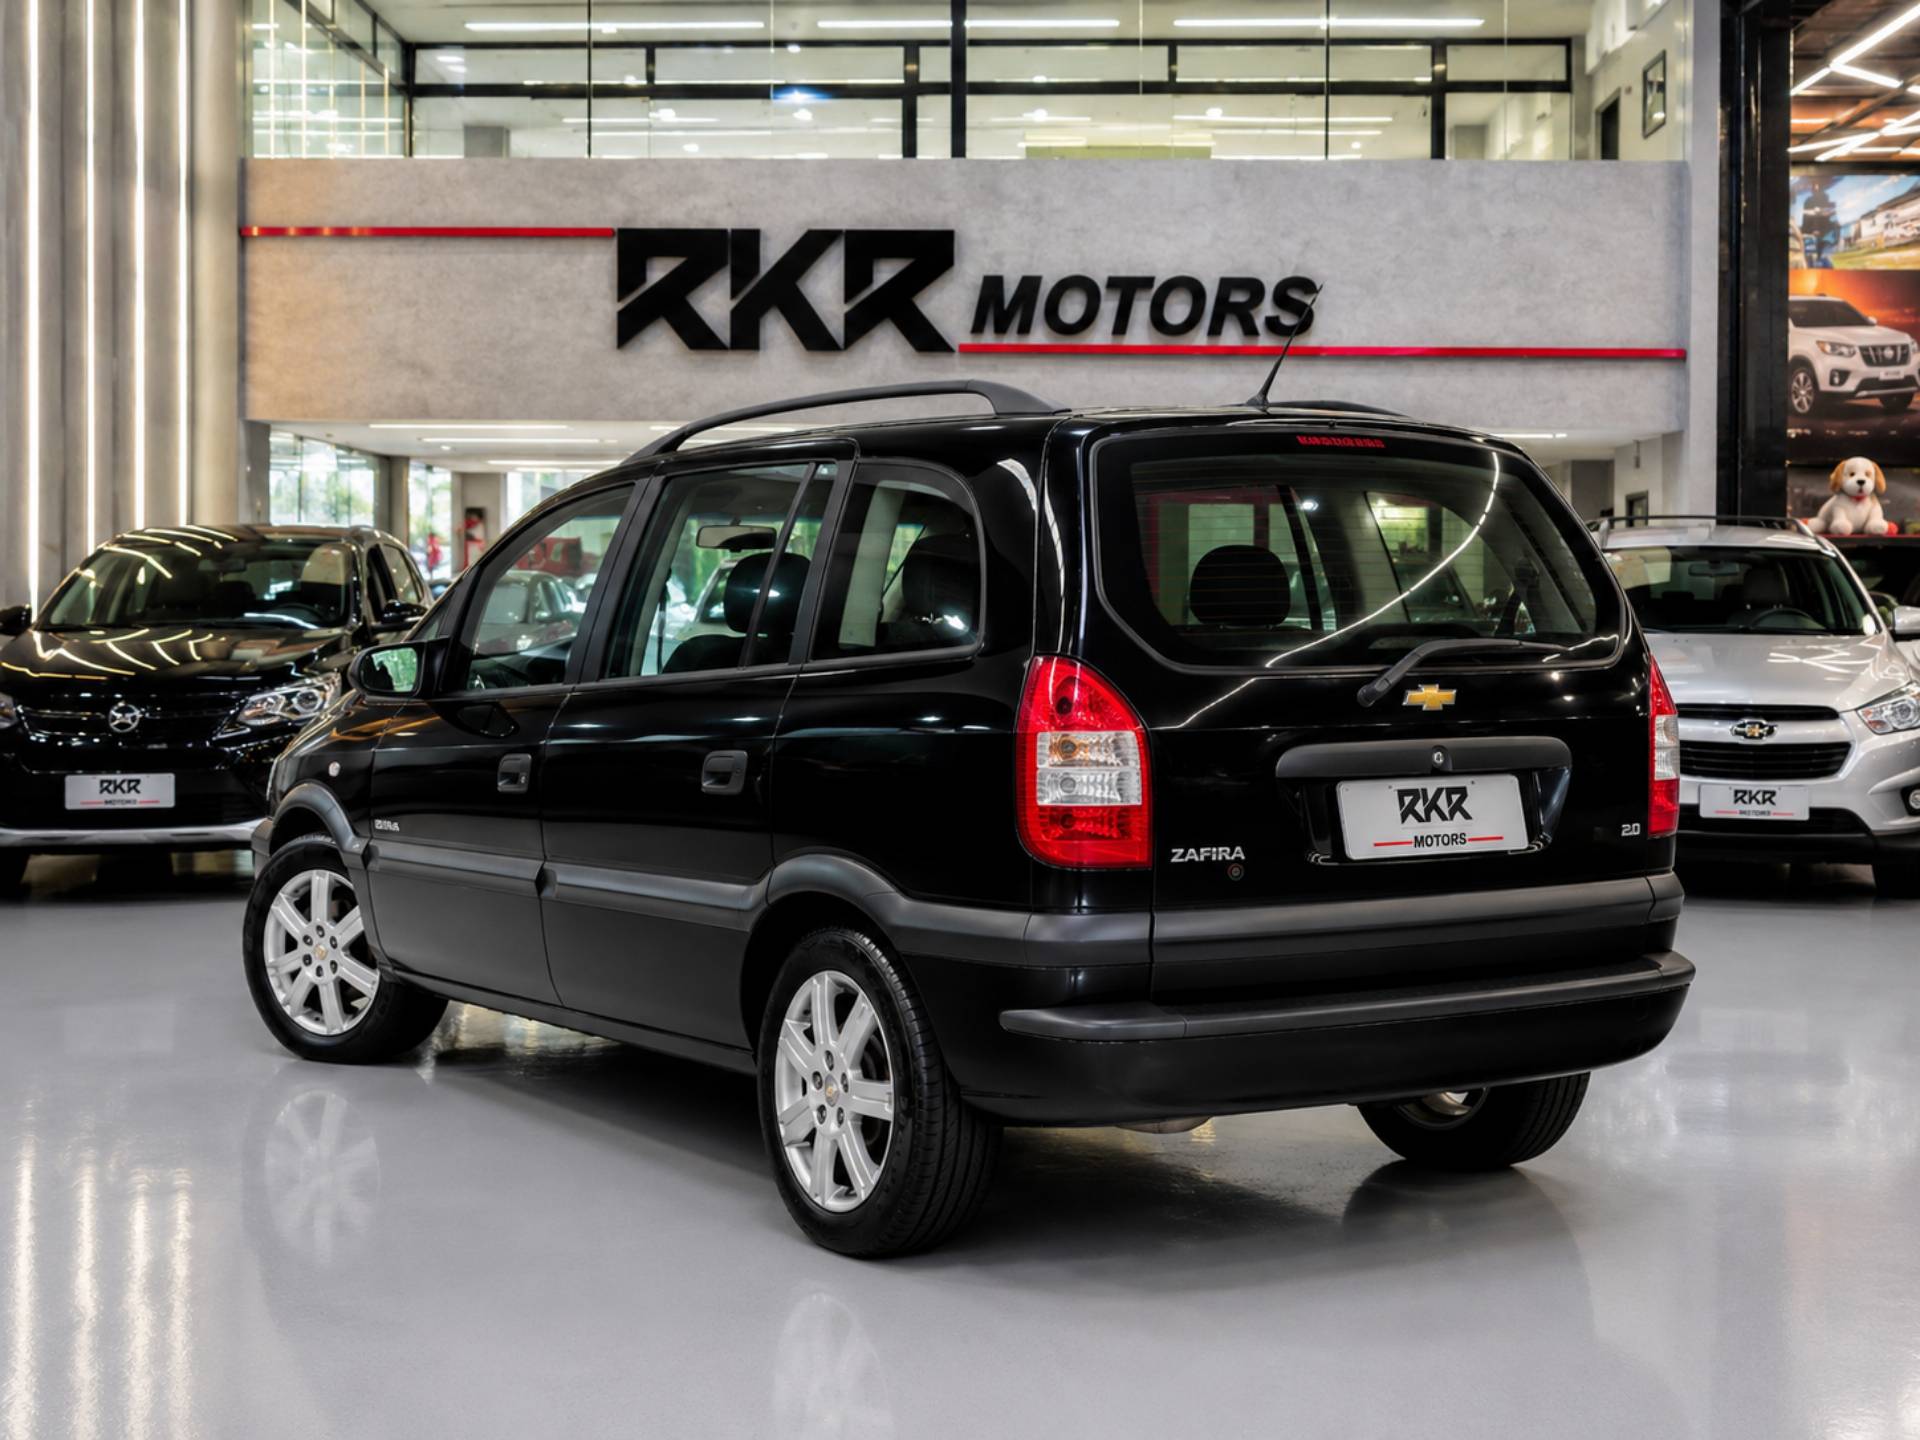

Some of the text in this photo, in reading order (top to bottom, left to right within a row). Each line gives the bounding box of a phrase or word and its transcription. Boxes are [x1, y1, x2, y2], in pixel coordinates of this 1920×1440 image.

[617, 228, 1318, 352] RKR MOTORS
[99, 779, 142, 795] RKR
[1396, 785, 1473, 825] RKR
[1733, 788, 1777, 806] RKR
[1413, 832, 1467, 848] MOTORS
[1170, 845, 1246, 863] ZAFIRA
